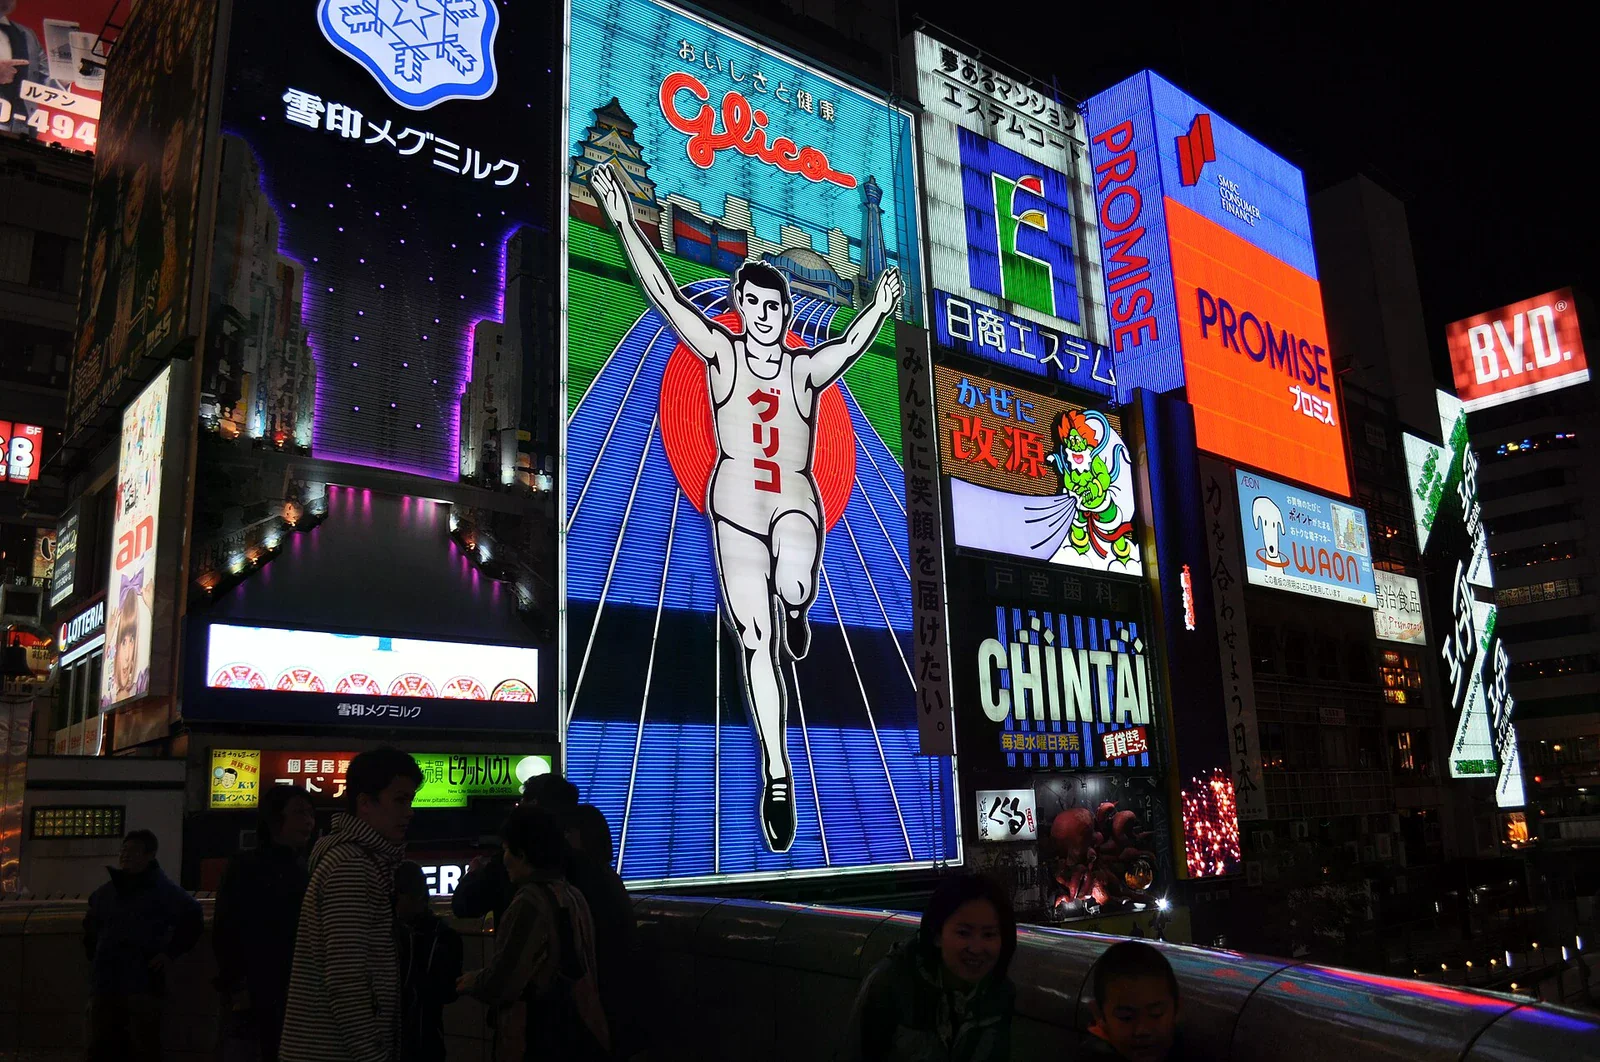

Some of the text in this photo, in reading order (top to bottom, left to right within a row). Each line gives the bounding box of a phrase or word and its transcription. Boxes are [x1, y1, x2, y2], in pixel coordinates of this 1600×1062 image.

[26, 86, 76, 106] ルアン
[678, 38, 836, 123] おいしさと健康
[940, 47, 1077, 131] 夢あるマンション
[282, 87, 519, 186] 雪印メグミルク
[659, 71, 857, 188] Glico
[942, 82, 1081, 163] エステムコート
[1217, 174, 1240, 196] SMBC
[1219, 187, 1261, 220] CONSUMER
[1221, 198, 1255, 226] FINANCE
[1092, 120, 1158, 353] PROMISE
[946, 298, 1117, 386] 日商エステム
[1197, 287, 1330, 394] PROMISE
[956, 377, 1035, 424] かぜに
[1288, 385, 1335, 427] プロミス
[747, 387, 781, 495] グリコ
[949, 414, 1047, 478] 改源
[115, 515, 154, 571] an
[901, 346, 946, 733] みんなに笑顔を届けたい。
[1291, 541, 1360, 585] WAON
[67, 601, 104, 643] LOTTERIA
[1206, 476, 1258, 805] 力を合わせよう日本
[337, 702, 422, 718] 雪印メグミルク
[448, 755, 512, 785] ピタットハウス
[1002, 733, 1080, 751] 毎週水曜日発売
